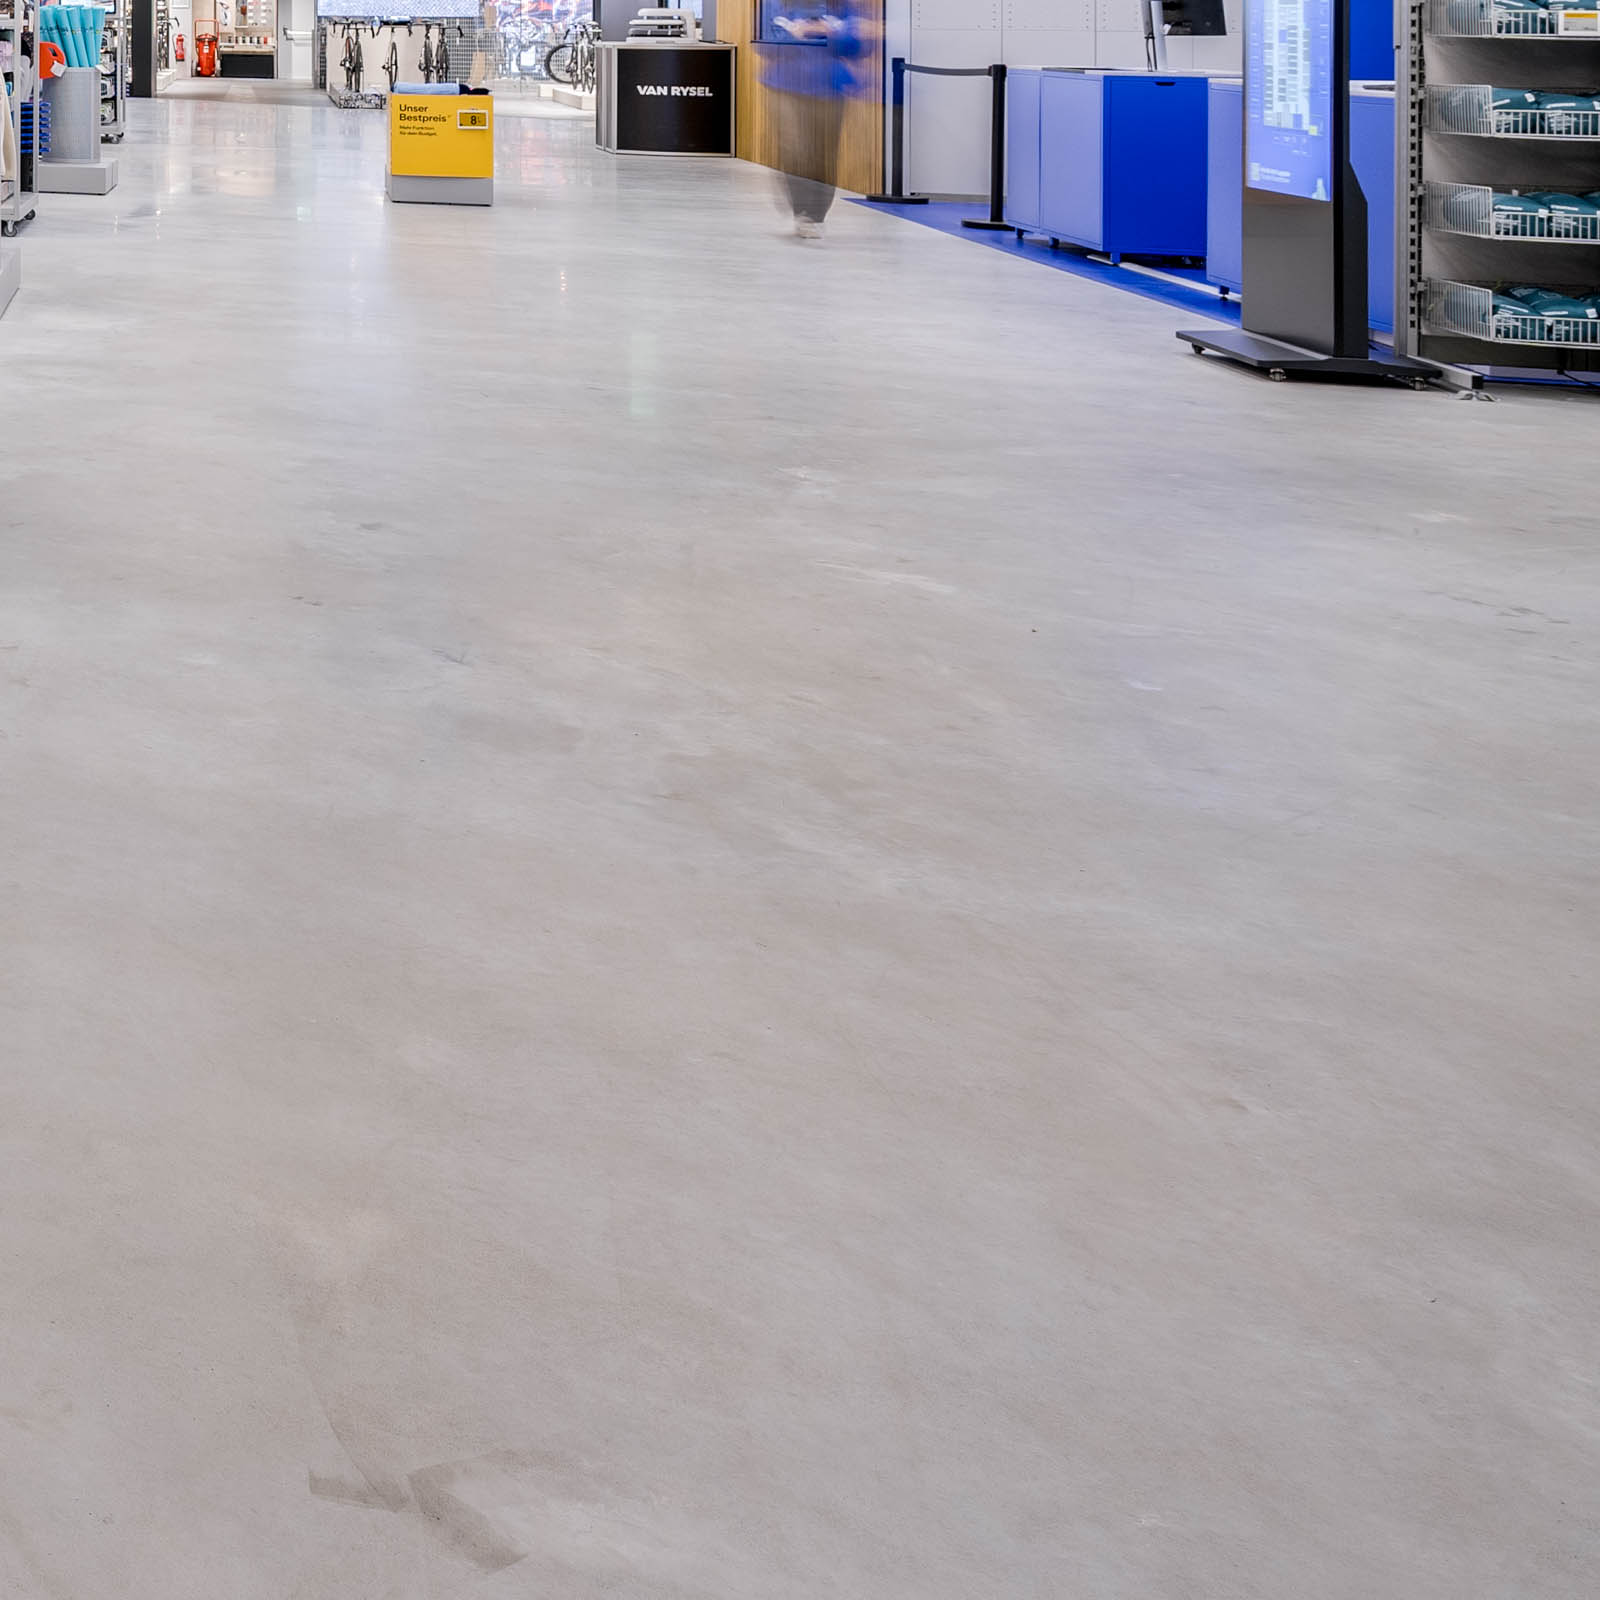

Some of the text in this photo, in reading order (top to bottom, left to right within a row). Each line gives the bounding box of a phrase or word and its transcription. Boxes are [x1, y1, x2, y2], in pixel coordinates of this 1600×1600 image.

[637, 85, 713, 97] VAN RYSEL
[399, 104, 429, 113] Unser
[399, 113, 447, 124] Bestpreis
[470, 115, 477, 126] 8
